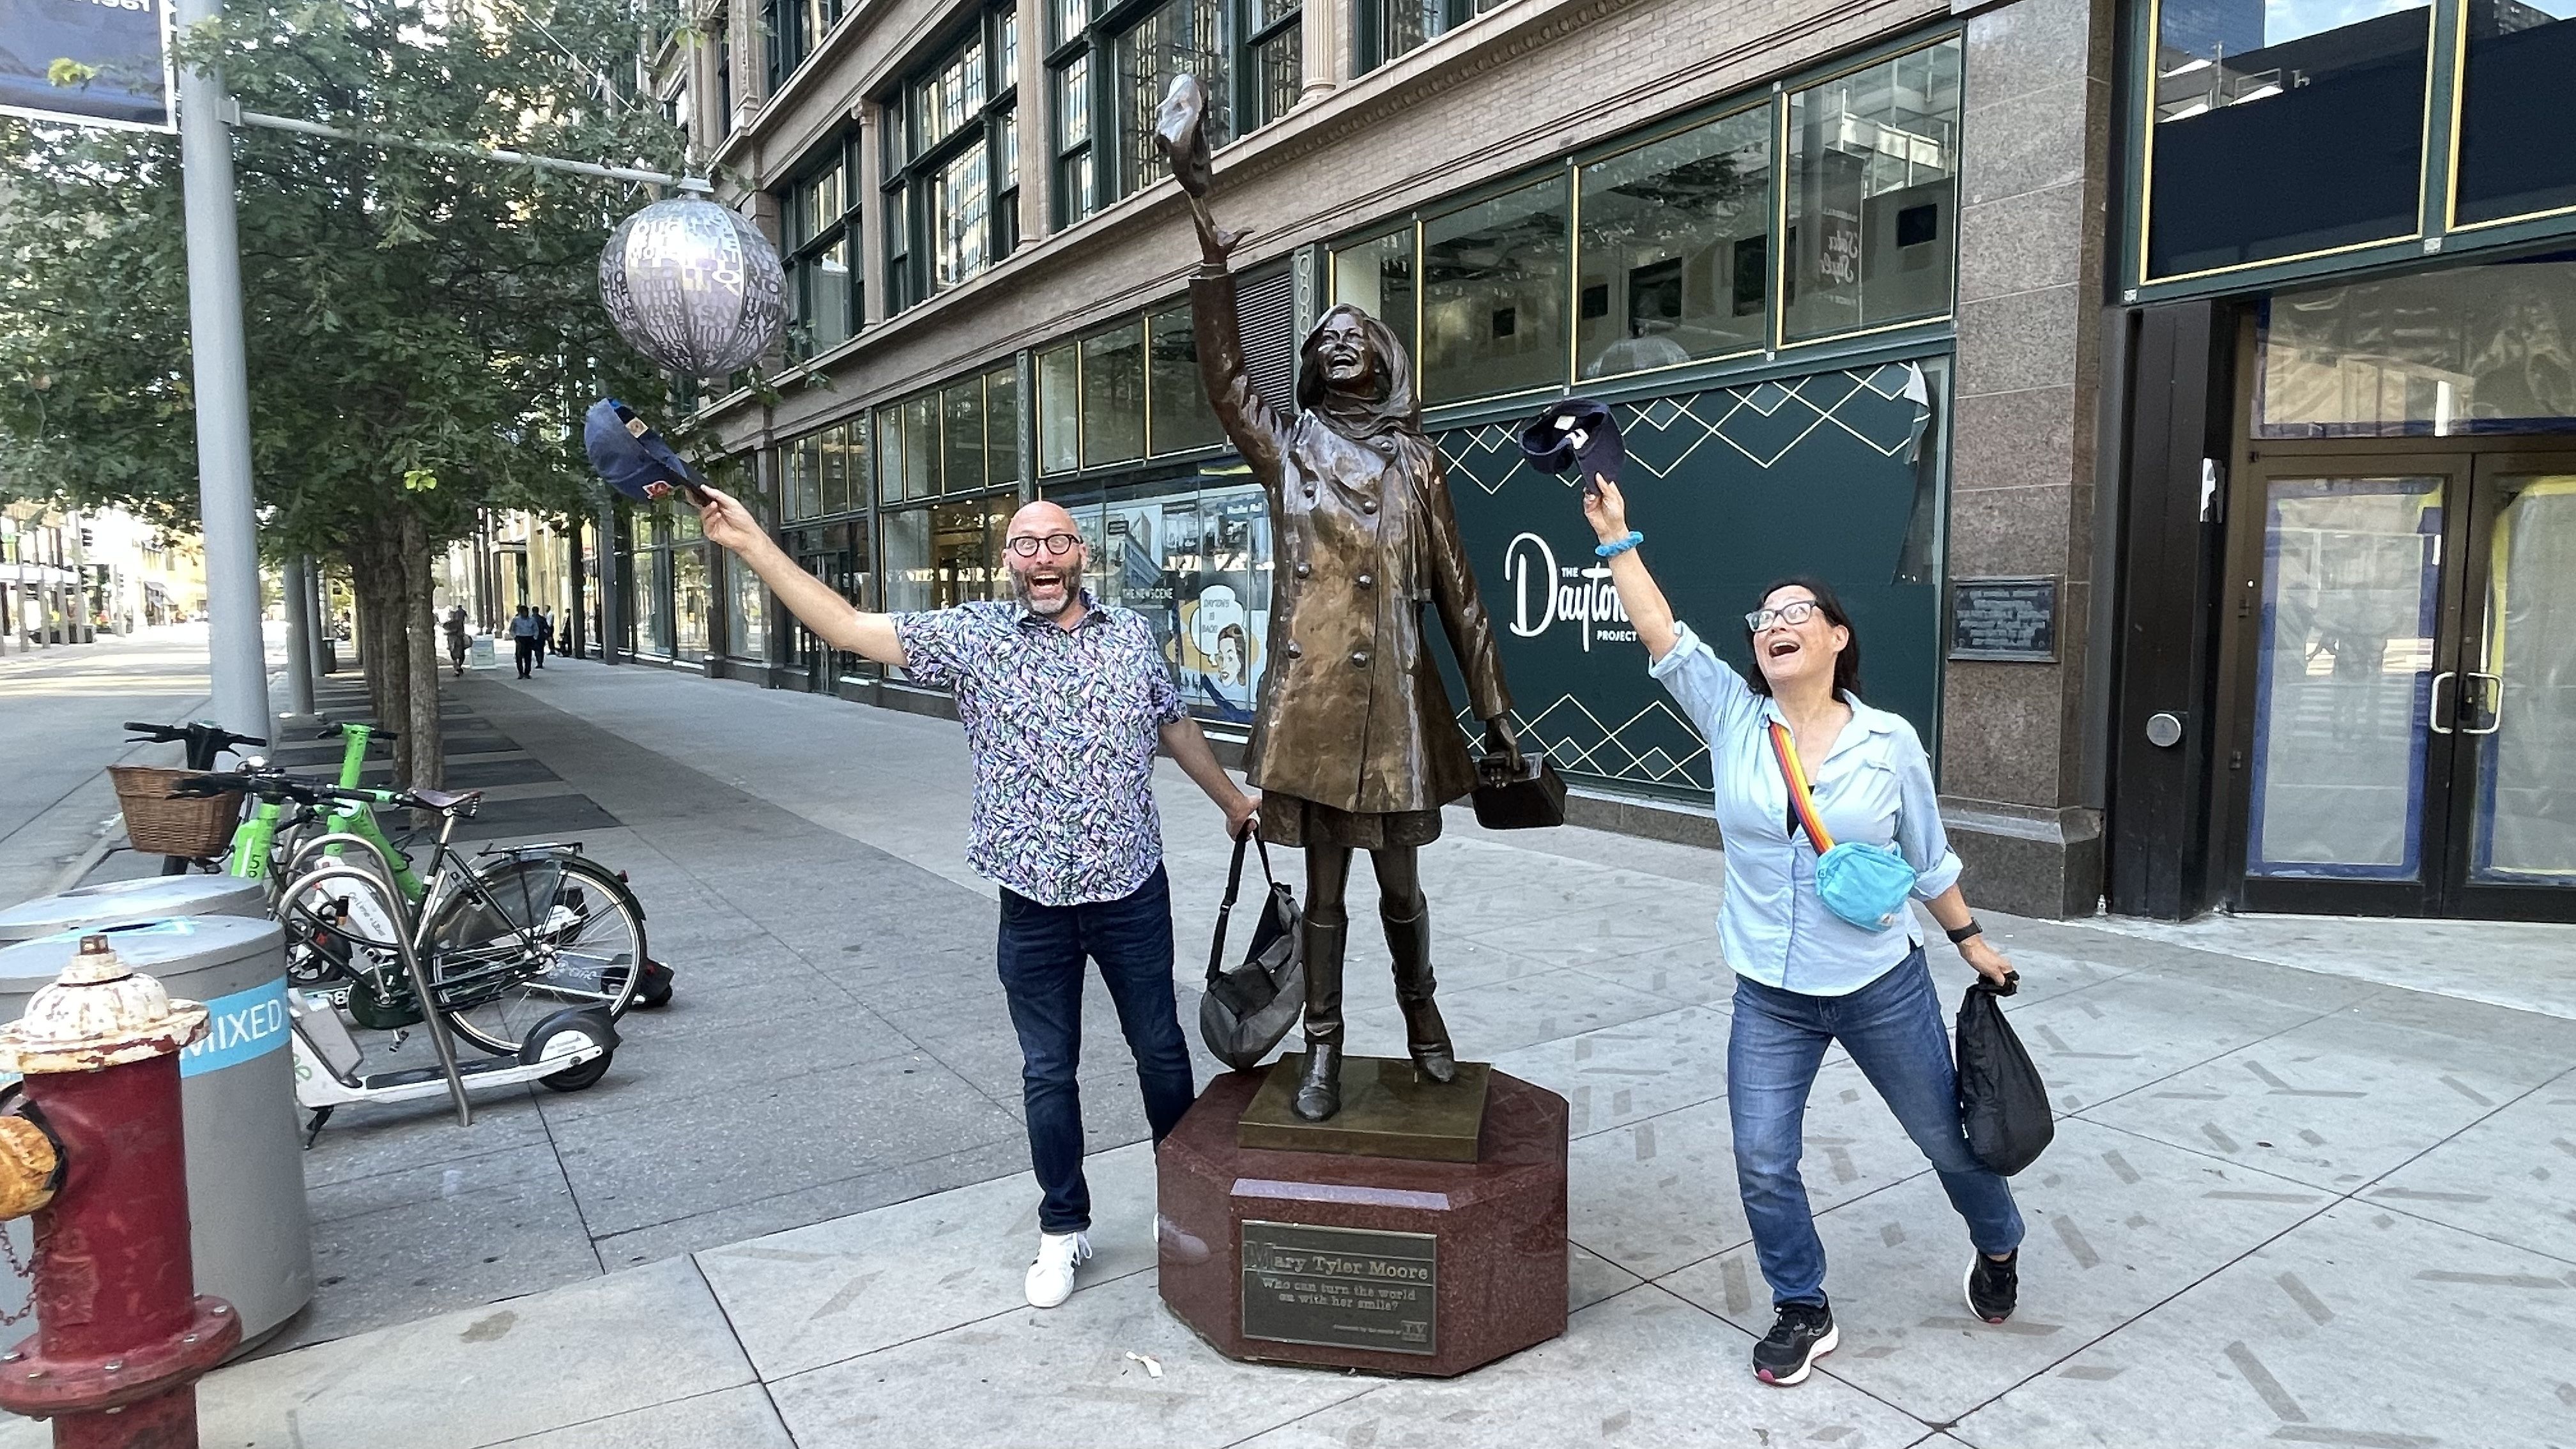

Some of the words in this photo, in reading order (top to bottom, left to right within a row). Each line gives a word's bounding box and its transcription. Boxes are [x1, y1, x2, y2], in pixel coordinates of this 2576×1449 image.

[1561, 567, 1579, 578] THE
[1596, 630, 1637, 642] PROJECT
[1243, 1240, 1307, 1273] Mary
[1313, 1255, 1362, 1275] Tyler
[1368, 1261, 1428, 1280] Moore
[1262, 1277, 1291, 1289] Who
[1294, 1282, 1317, 1292] can
[1321, 1283, 1349, 1294] turn
[1354, 1285, 1375, 1298] the
[1378, 1289, 1416, 1301] world
[1278, 1293, 1296, 1302] on
[1298, 1293, 1328, 1305] with
[1331, 1296, 1353, 1308] her
